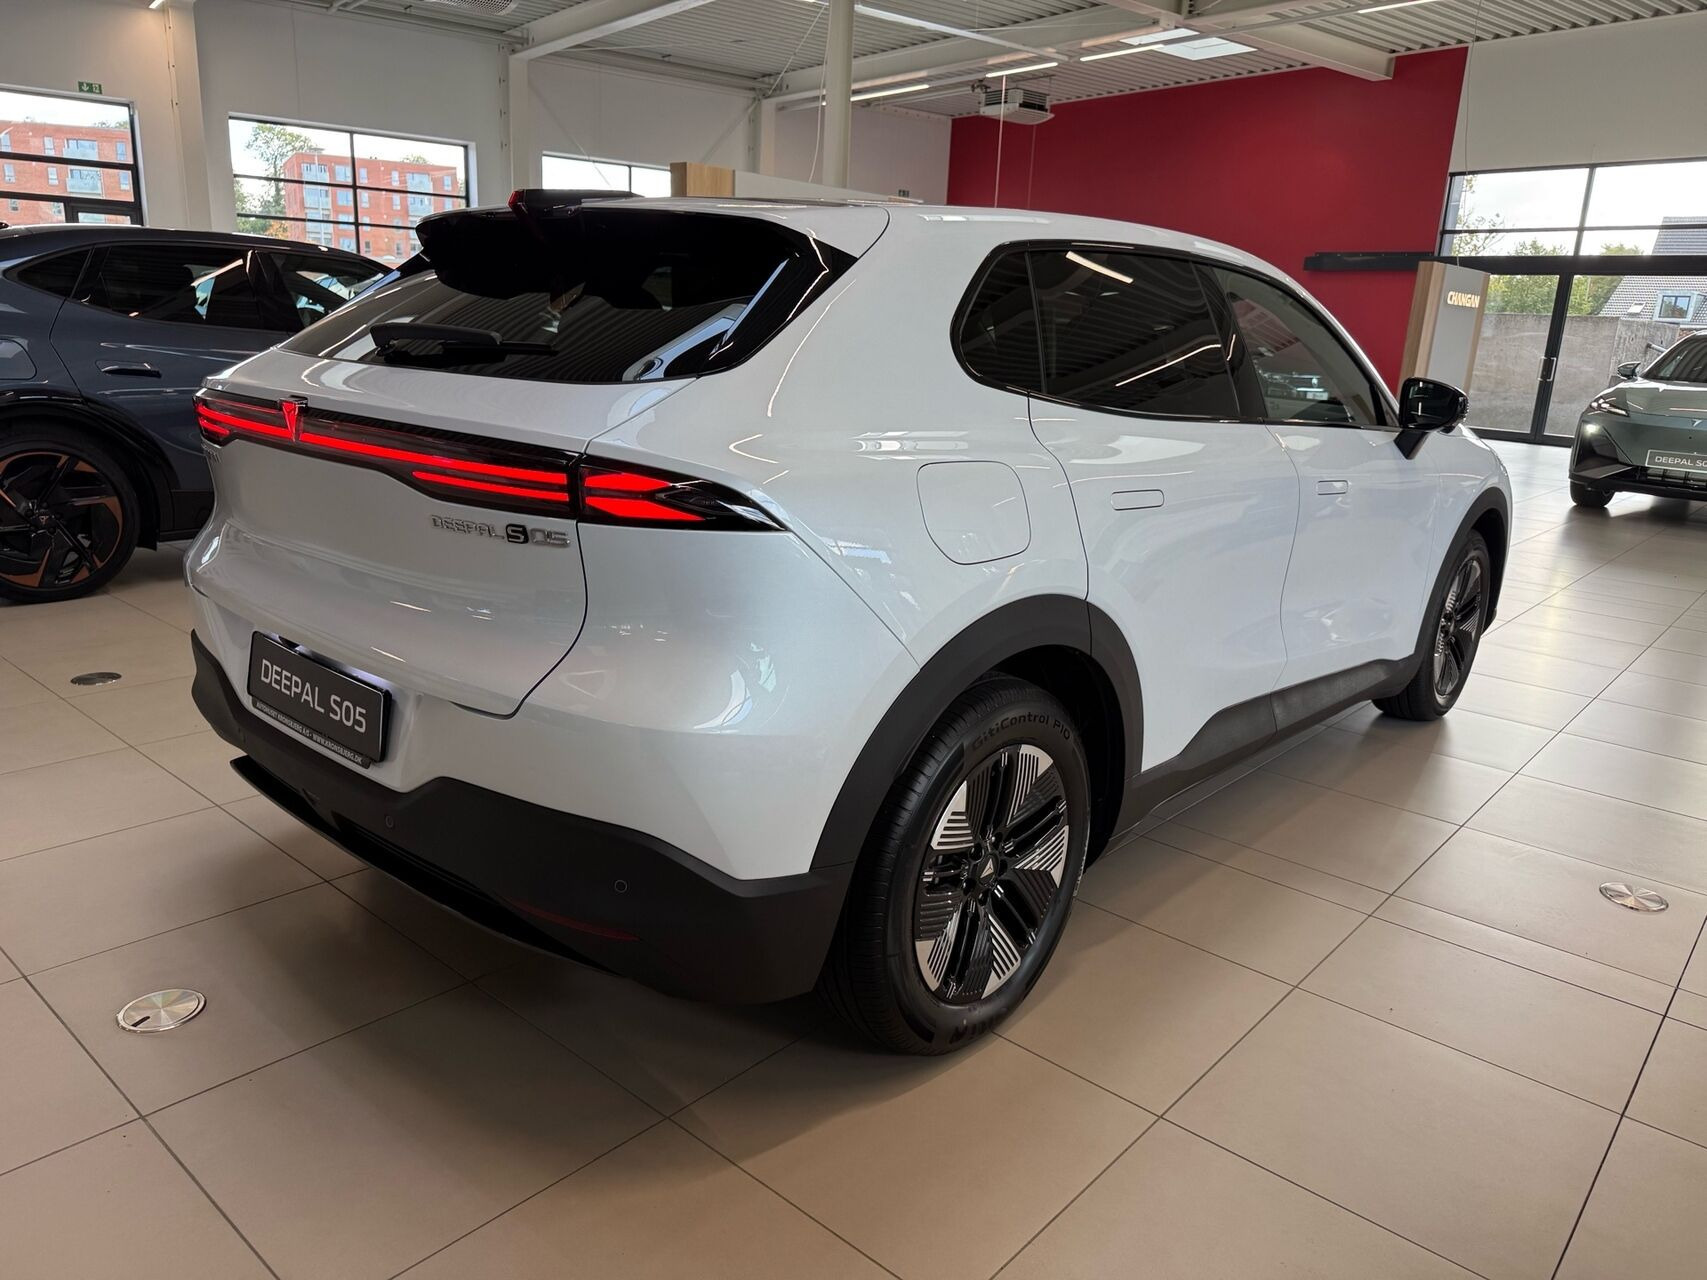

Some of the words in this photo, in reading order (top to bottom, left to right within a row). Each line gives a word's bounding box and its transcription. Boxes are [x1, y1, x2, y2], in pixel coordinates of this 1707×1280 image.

[1447, 291, 1480, 308] CHANGAN
[1655, 456, 1693, 466] DEEPAL
[431, 514, 505, 540] DEEPAL
[260, 658, 325, 714] DEEPAL
[329, 694, 367, 734] S05
[971, 711, 1049, 751] GitiControl
